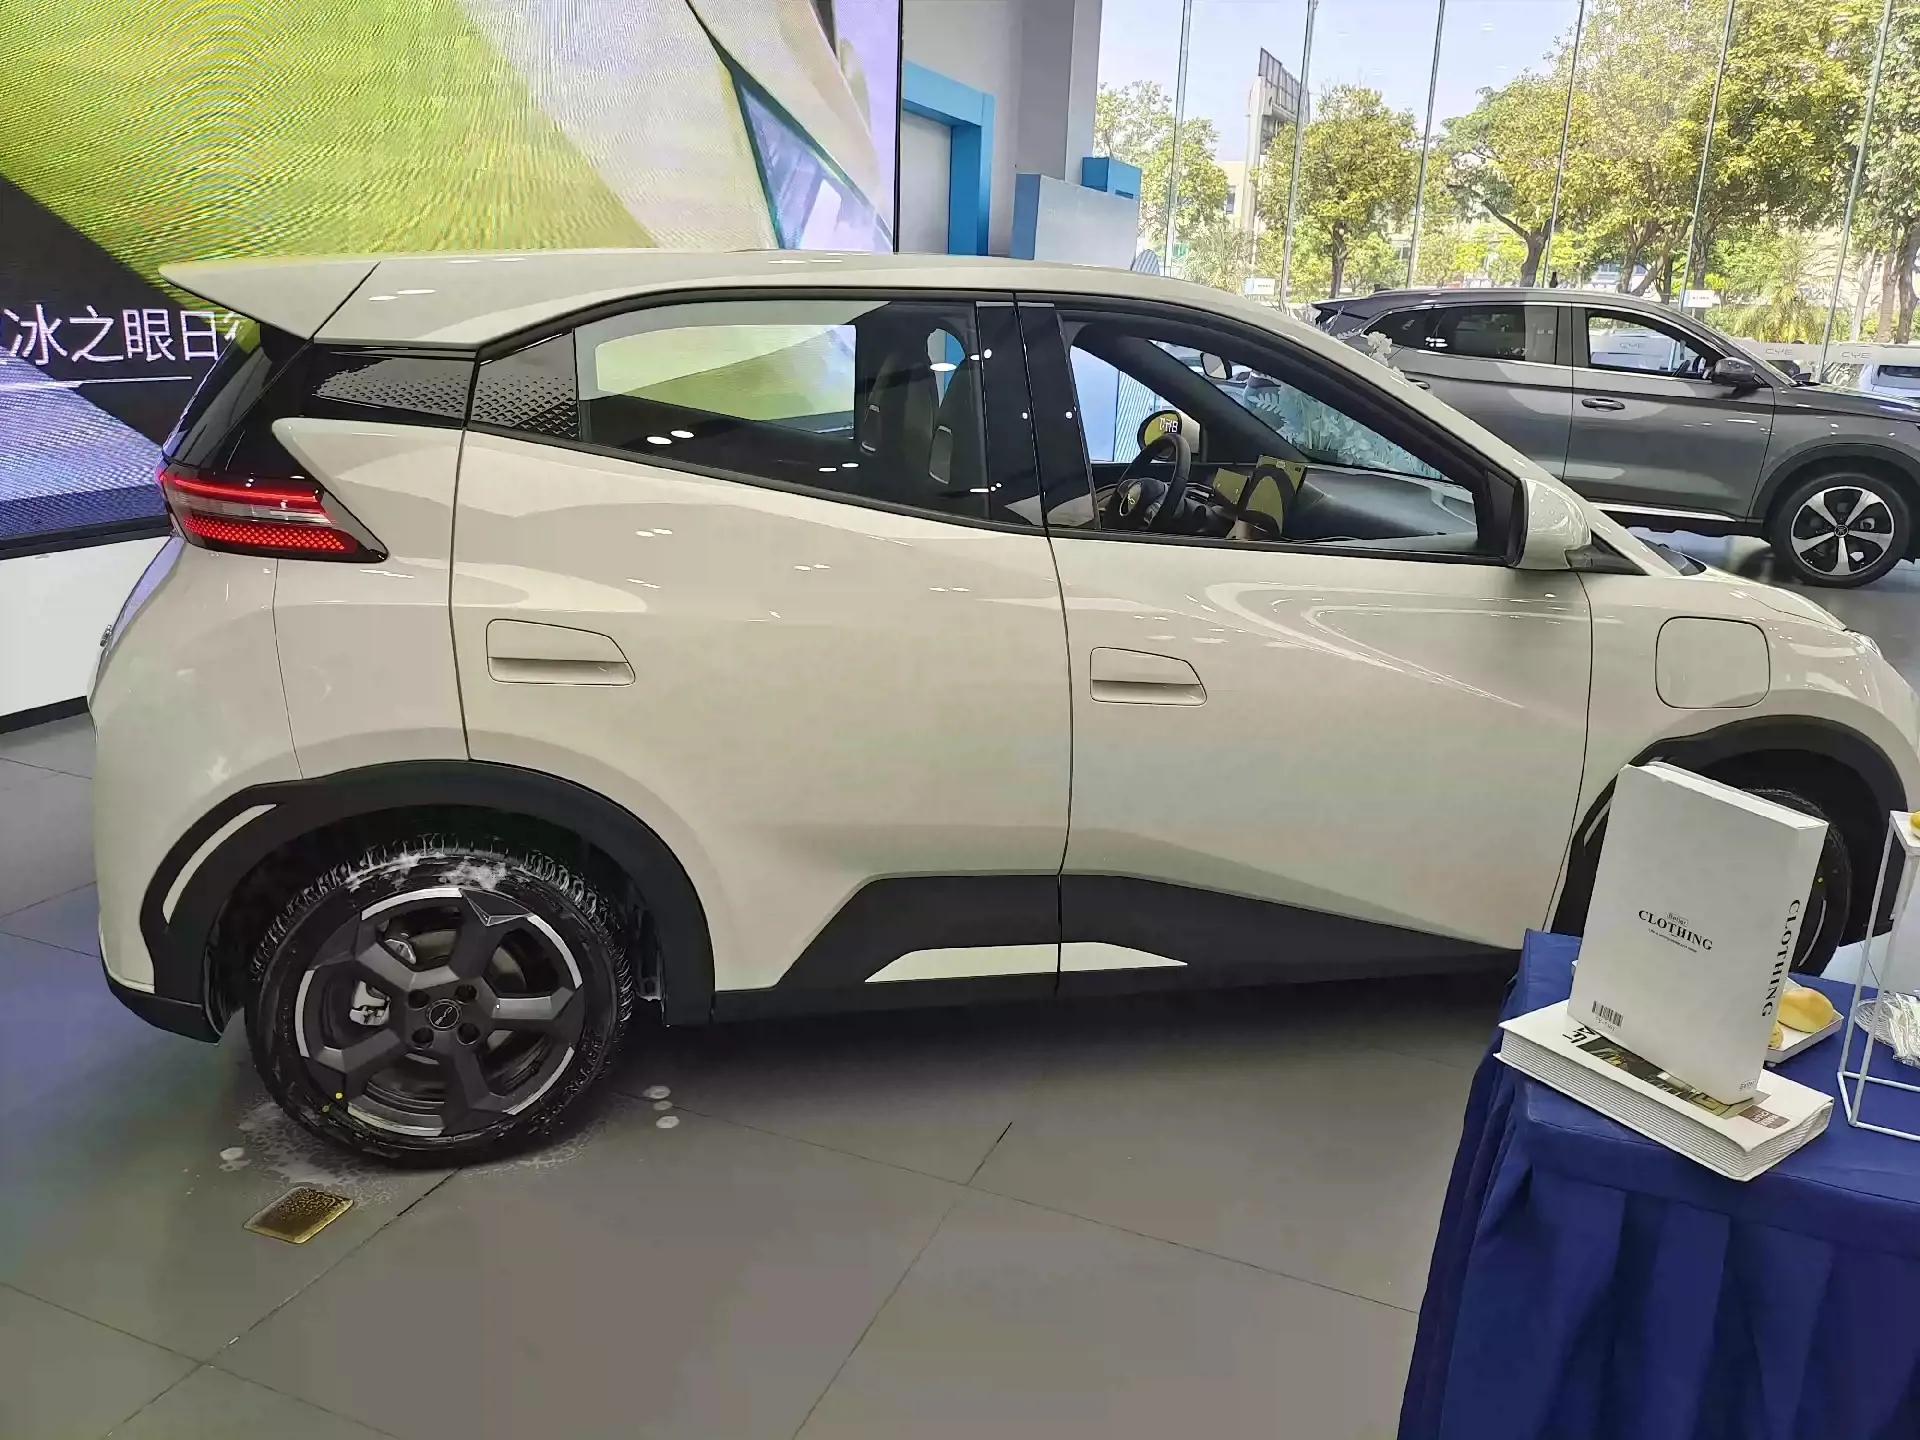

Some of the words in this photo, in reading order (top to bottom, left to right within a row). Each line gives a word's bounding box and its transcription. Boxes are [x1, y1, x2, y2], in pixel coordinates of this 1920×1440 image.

[4, 304, 241, 367] 冰之眼日
[1638, 910, 1713, 950] CLOTHING
[1761, 899, 1801, 1017] CLOTHING
